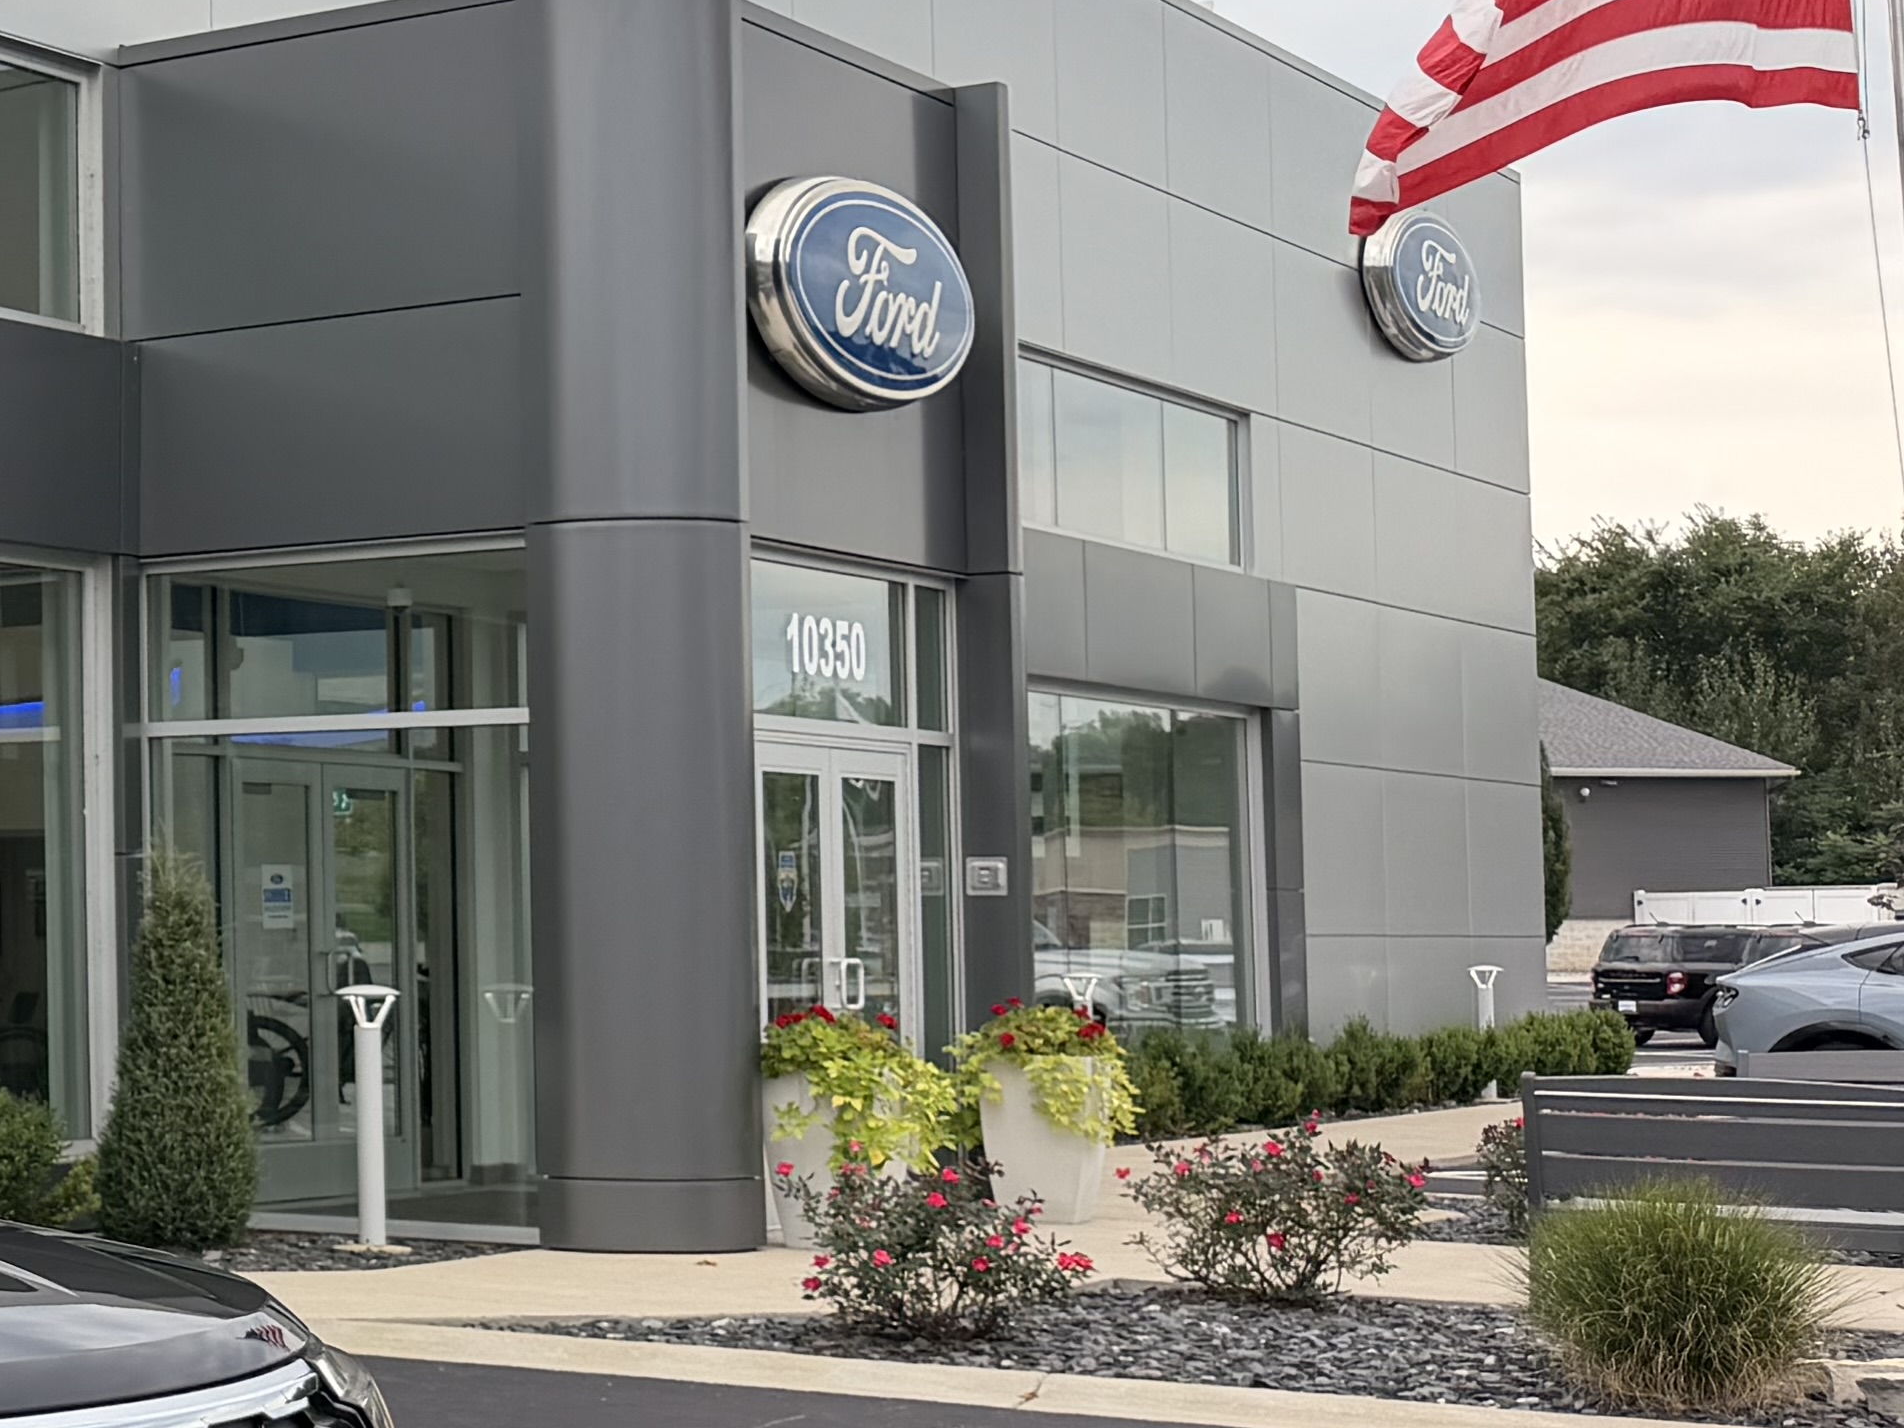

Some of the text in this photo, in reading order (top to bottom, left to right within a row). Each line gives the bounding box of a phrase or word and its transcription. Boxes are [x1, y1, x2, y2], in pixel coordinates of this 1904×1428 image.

[835, 226, 942, 359] Ford
[1417, 239, 1470, 326] Ford
[787, 612, 866, 682] 10350
